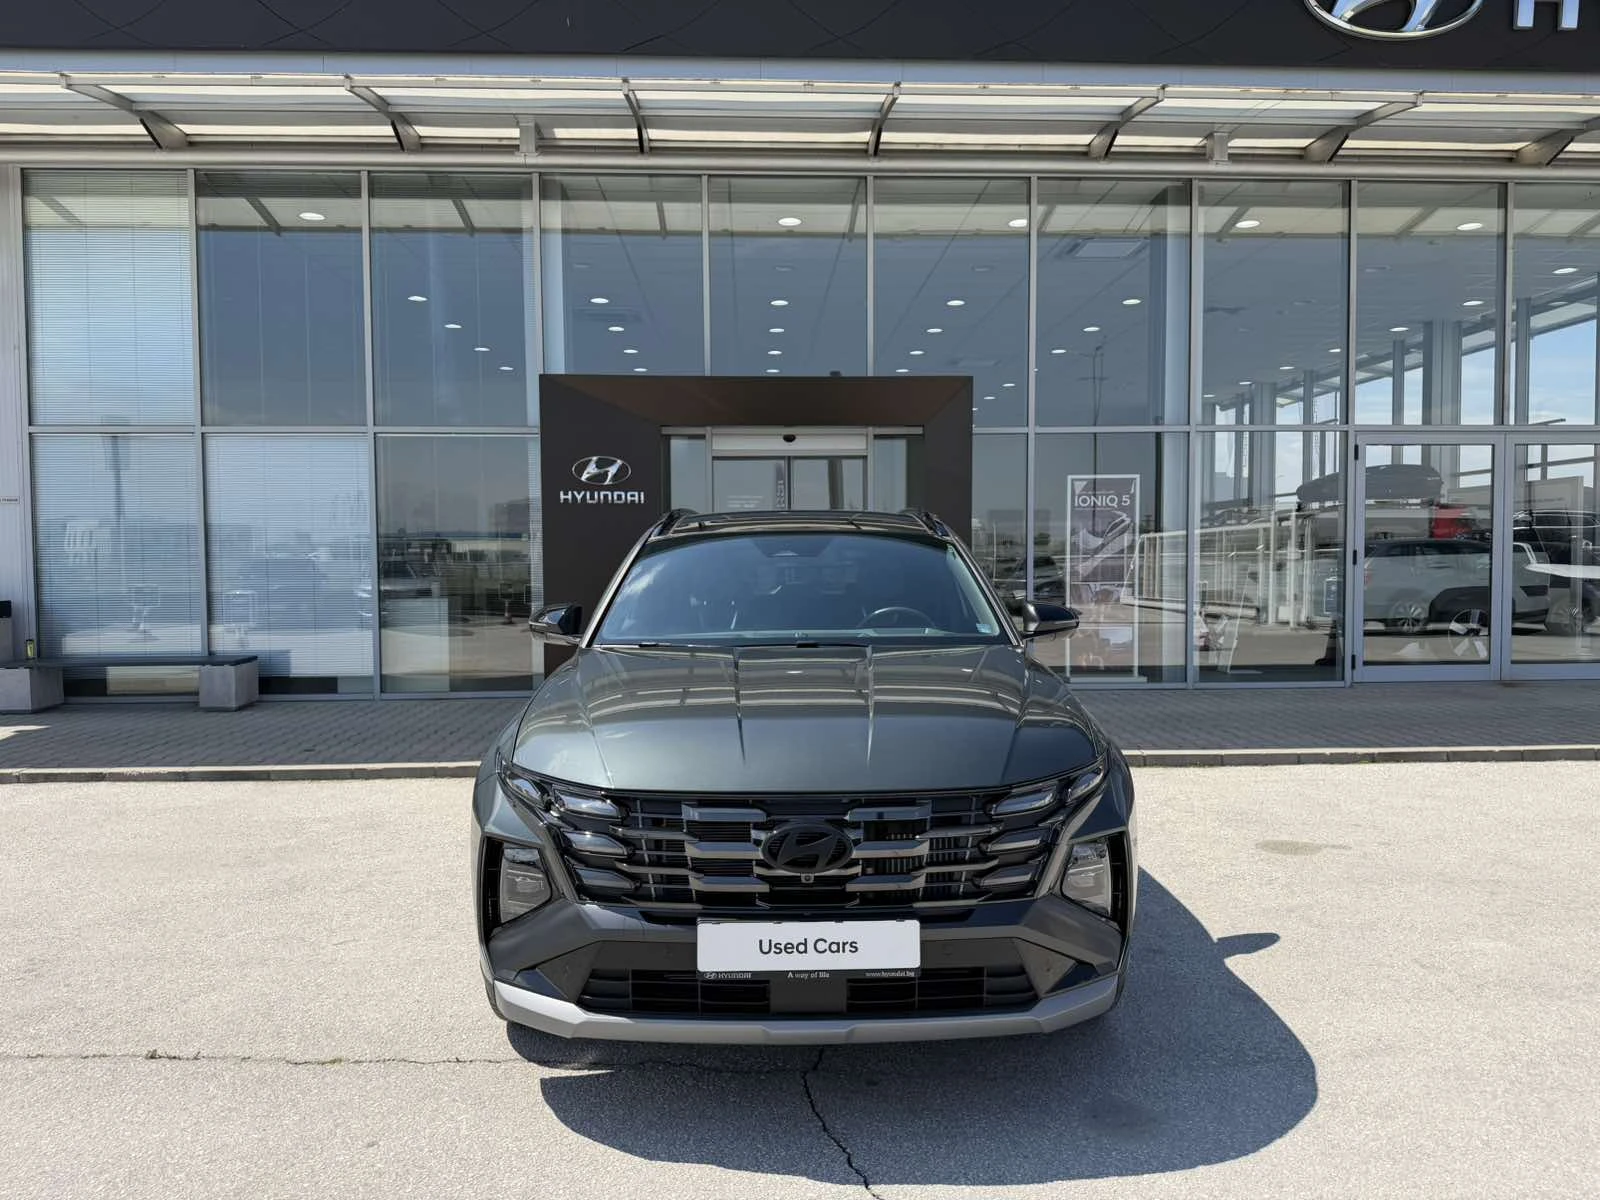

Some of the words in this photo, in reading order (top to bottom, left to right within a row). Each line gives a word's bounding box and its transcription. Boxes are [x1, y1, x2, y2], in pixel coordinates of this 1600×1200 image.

[559, 490, 645, 504] HYUNDAI
[1074, 495, 1118, 508] IONIQ
[1121, 494, 1130, 506] 5
[758, 938, 808, 955] Used
[813, 937, 859, 954] Cars
[787, 971, 794, 979] A
